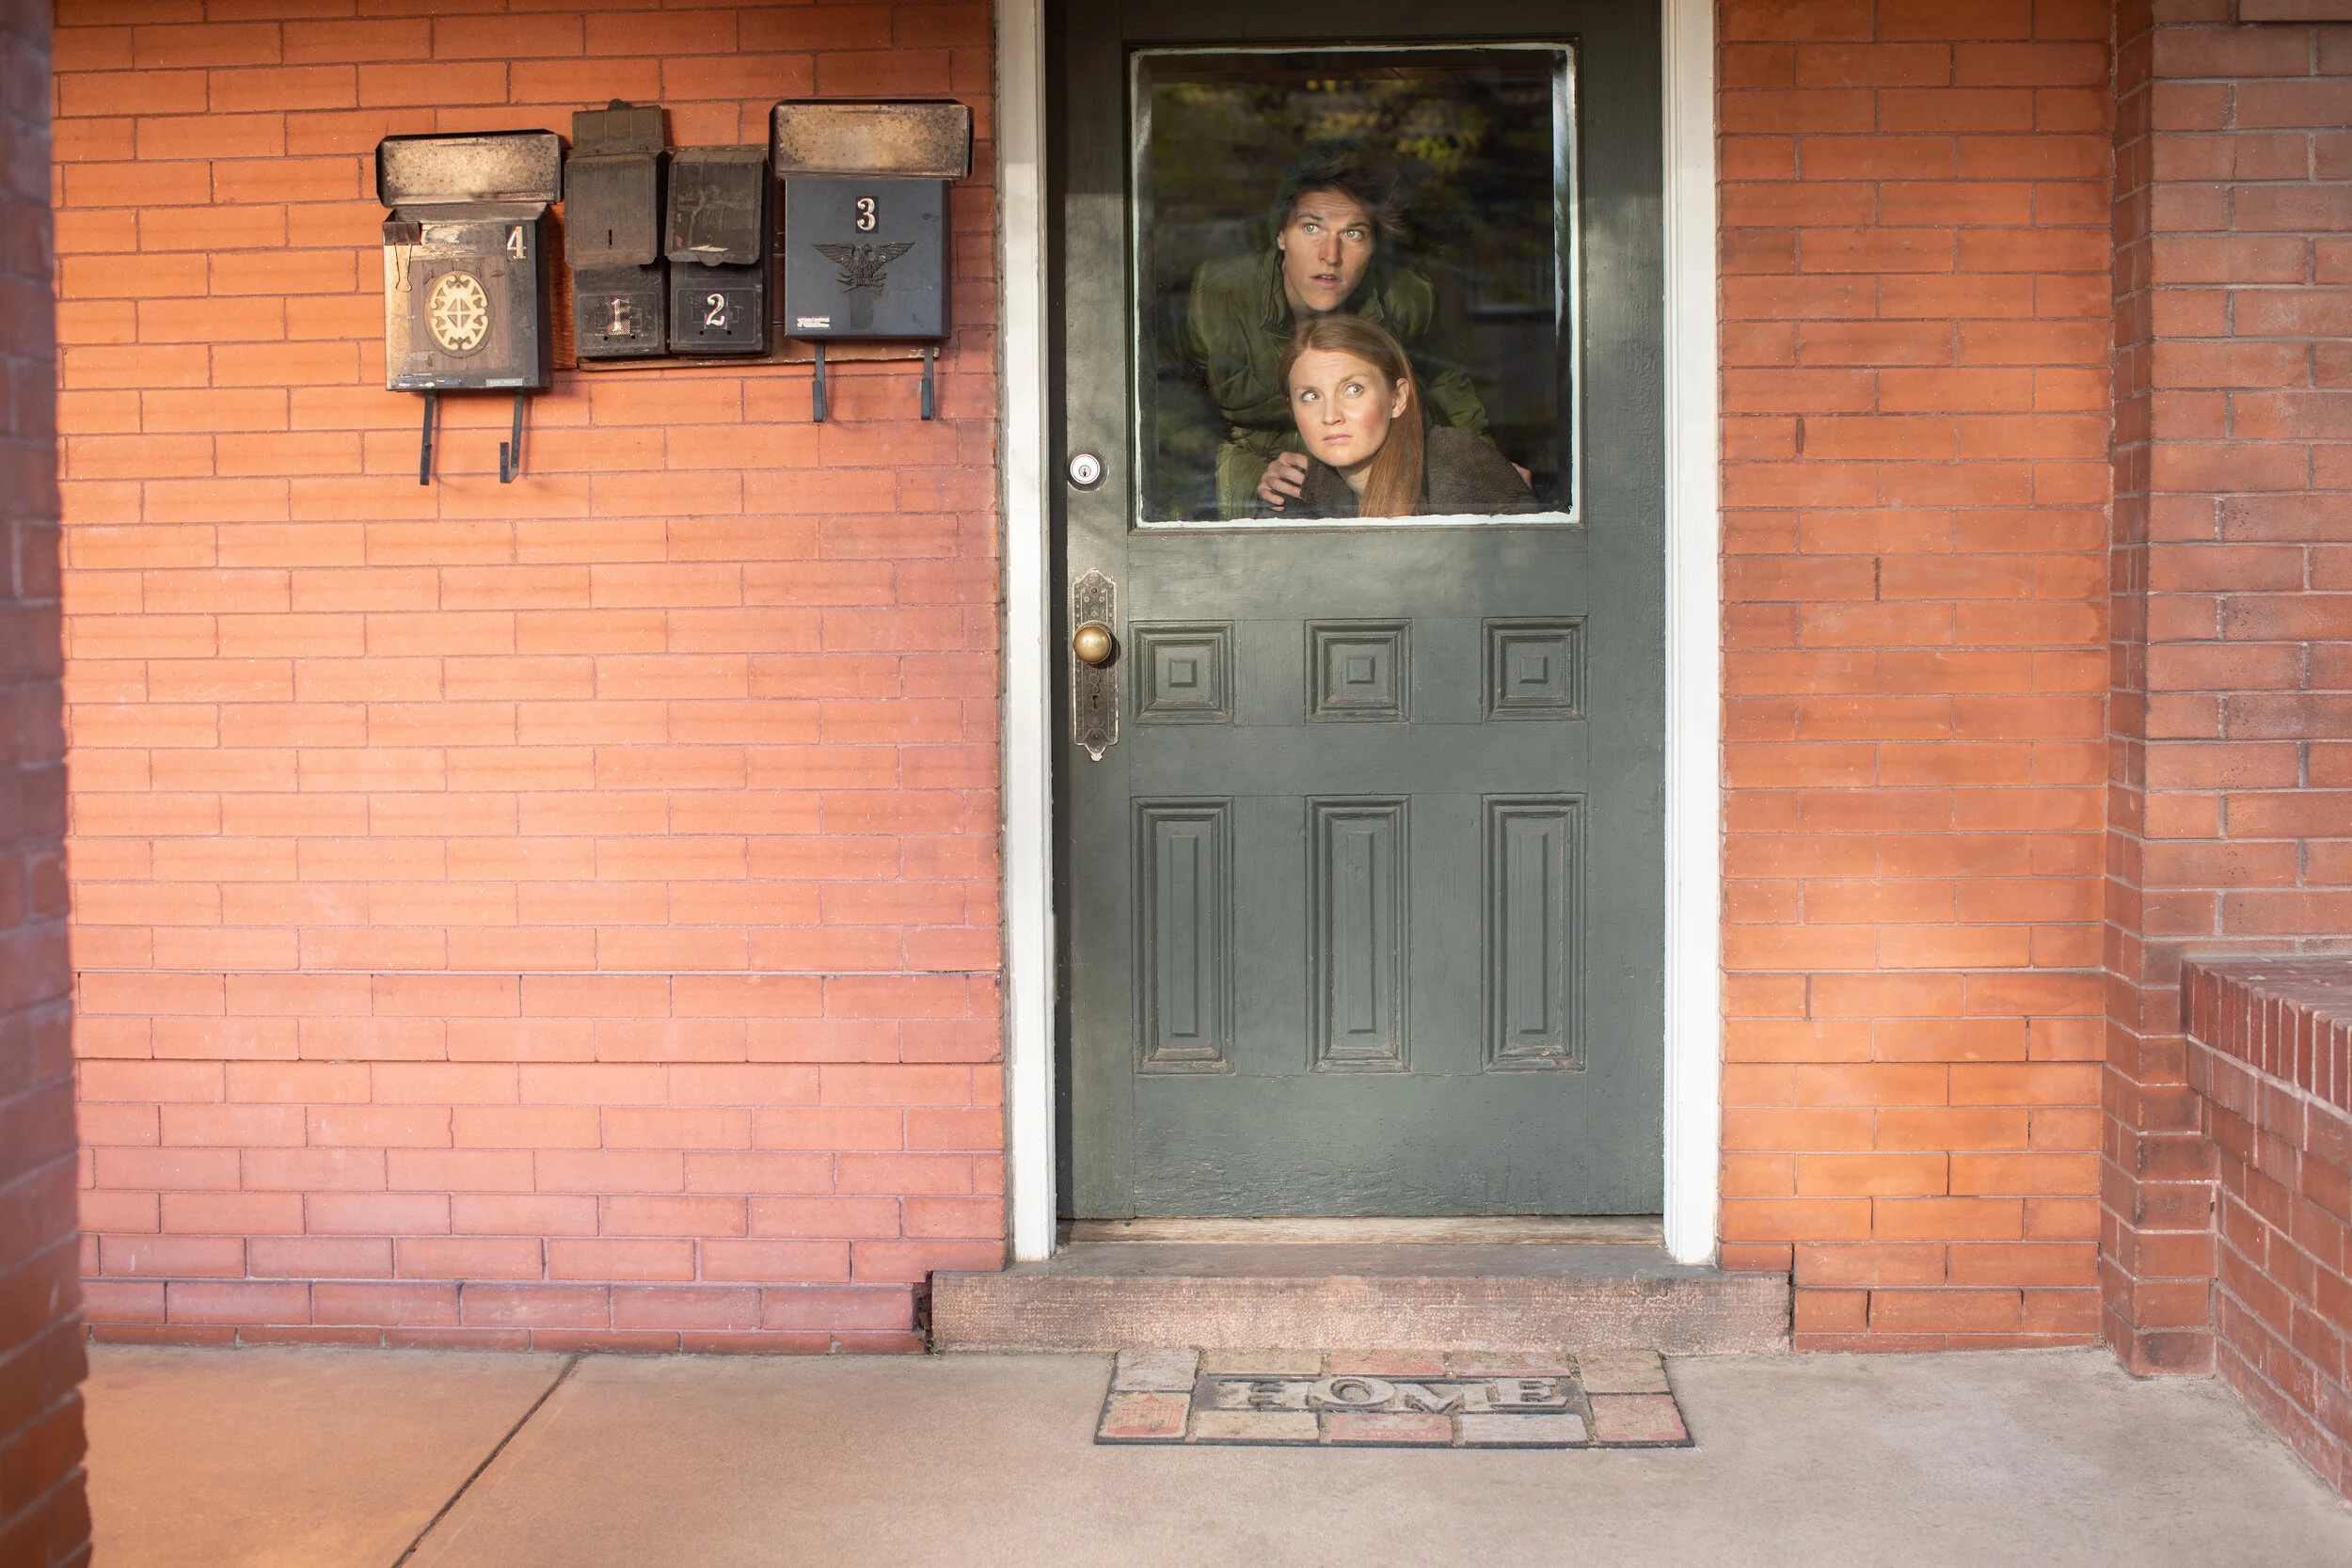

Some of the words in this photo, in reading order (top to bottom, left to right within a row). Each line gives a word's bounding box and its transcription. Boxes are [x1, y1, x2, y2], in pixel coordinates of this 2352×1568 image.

[856, 197, 876, 231] 3
[506, 225, 528, 260] 4
[706, 293, 726, 326] 2
[1217, 1376, 1569, 1412] HOME
